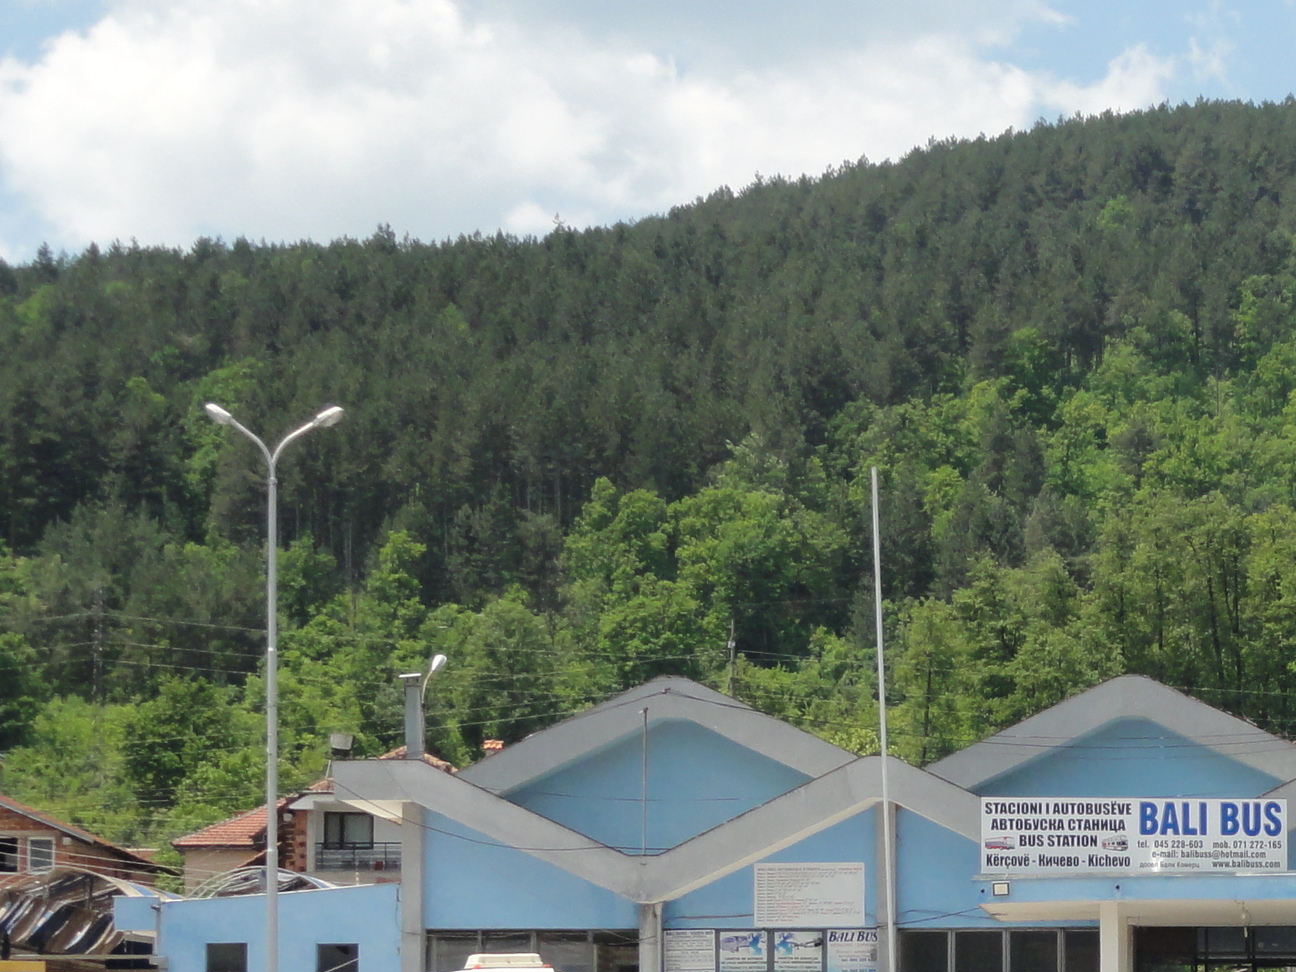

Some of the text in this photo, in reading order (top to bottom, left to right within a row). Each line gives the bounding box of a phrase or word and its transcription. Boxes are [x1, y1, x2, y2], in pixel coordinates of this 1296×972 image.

[985, 802, 1042, 815] STACIONI
[1052, 800, 1132, 816] AUTOBUSËVE
[991, 818, 1126, 833] АВТОБУСКА СТАНИЦА
[1139, 801, 1282, 837] BALI BUS
[1019, 834, 1098, 847] BUS STATION
[1137, 840, 1150, 849] tel.
[1154, 840, 1169, 849] 045
[1213, 840, 1231, 849] mob.
[1233, 840, 1247, 849] 071
[986, 853, 1030, 869] Kërçovë
[1038, 853, 1079, 867] Кичево
[1088, 853, 1130, 867] Kichevo
[1152, 850, 1179, 858] e-mail:
[829, 931, 878, 942] BALI BUS
